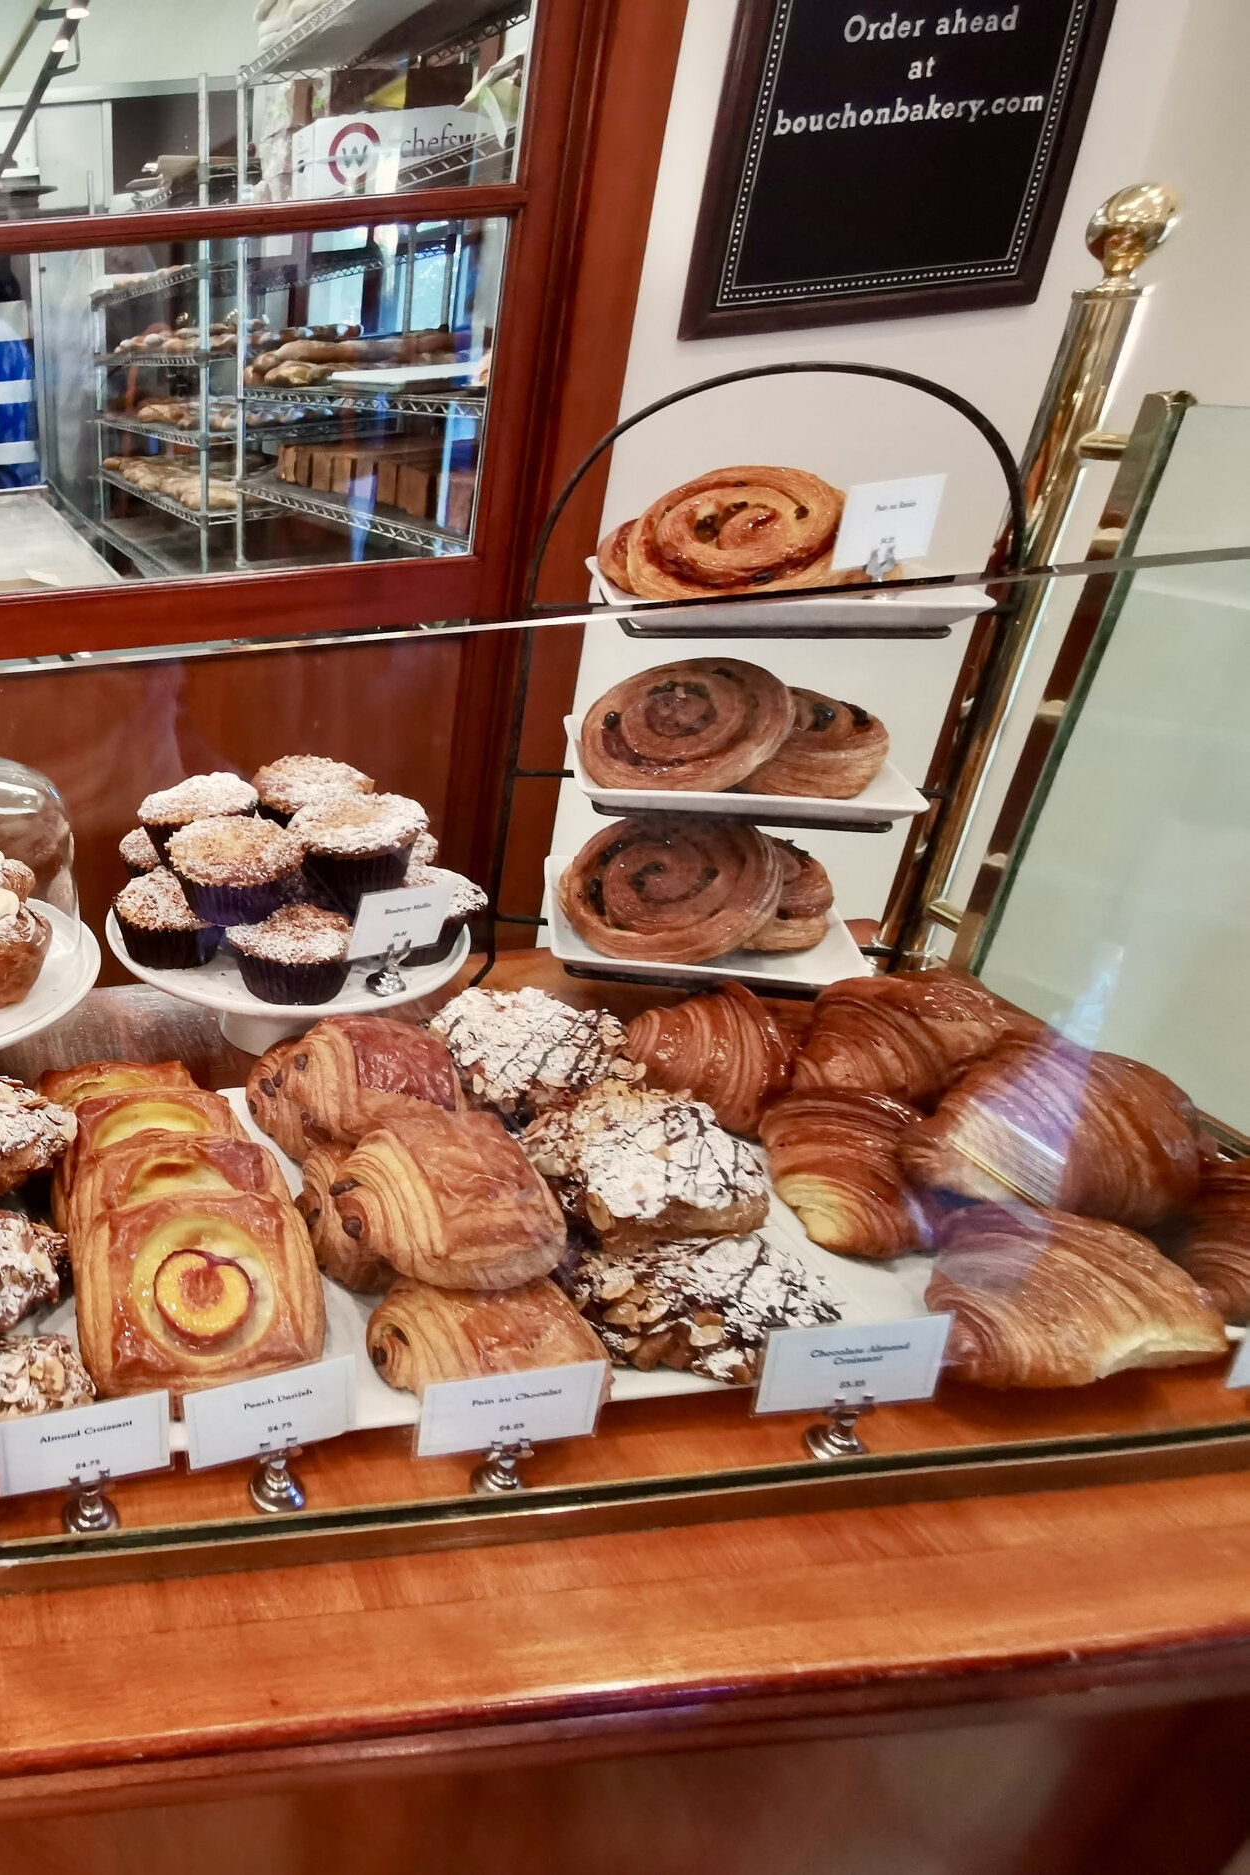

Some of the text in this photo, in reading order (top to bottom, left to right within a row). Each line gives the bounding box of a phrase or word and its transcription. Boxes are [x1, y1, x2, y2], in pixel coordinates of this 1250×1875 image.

[844, 5, 1019, 42] Order ahead
[908, 56, 935, 80] at
[773, 94, 1043, 136] bouchonbakery.com
[810, 1342, 910, 1358] Chocolate Almond
[833, 1355, 883, 1365] Croissant
[244, 1389, 313, 1410] Peach Danish
[472, 1399, 495, 1407] Pain
[515, 1388, 563, 1401] Chocolat
[40, 1420, 133, 1444] Almond Croissant
